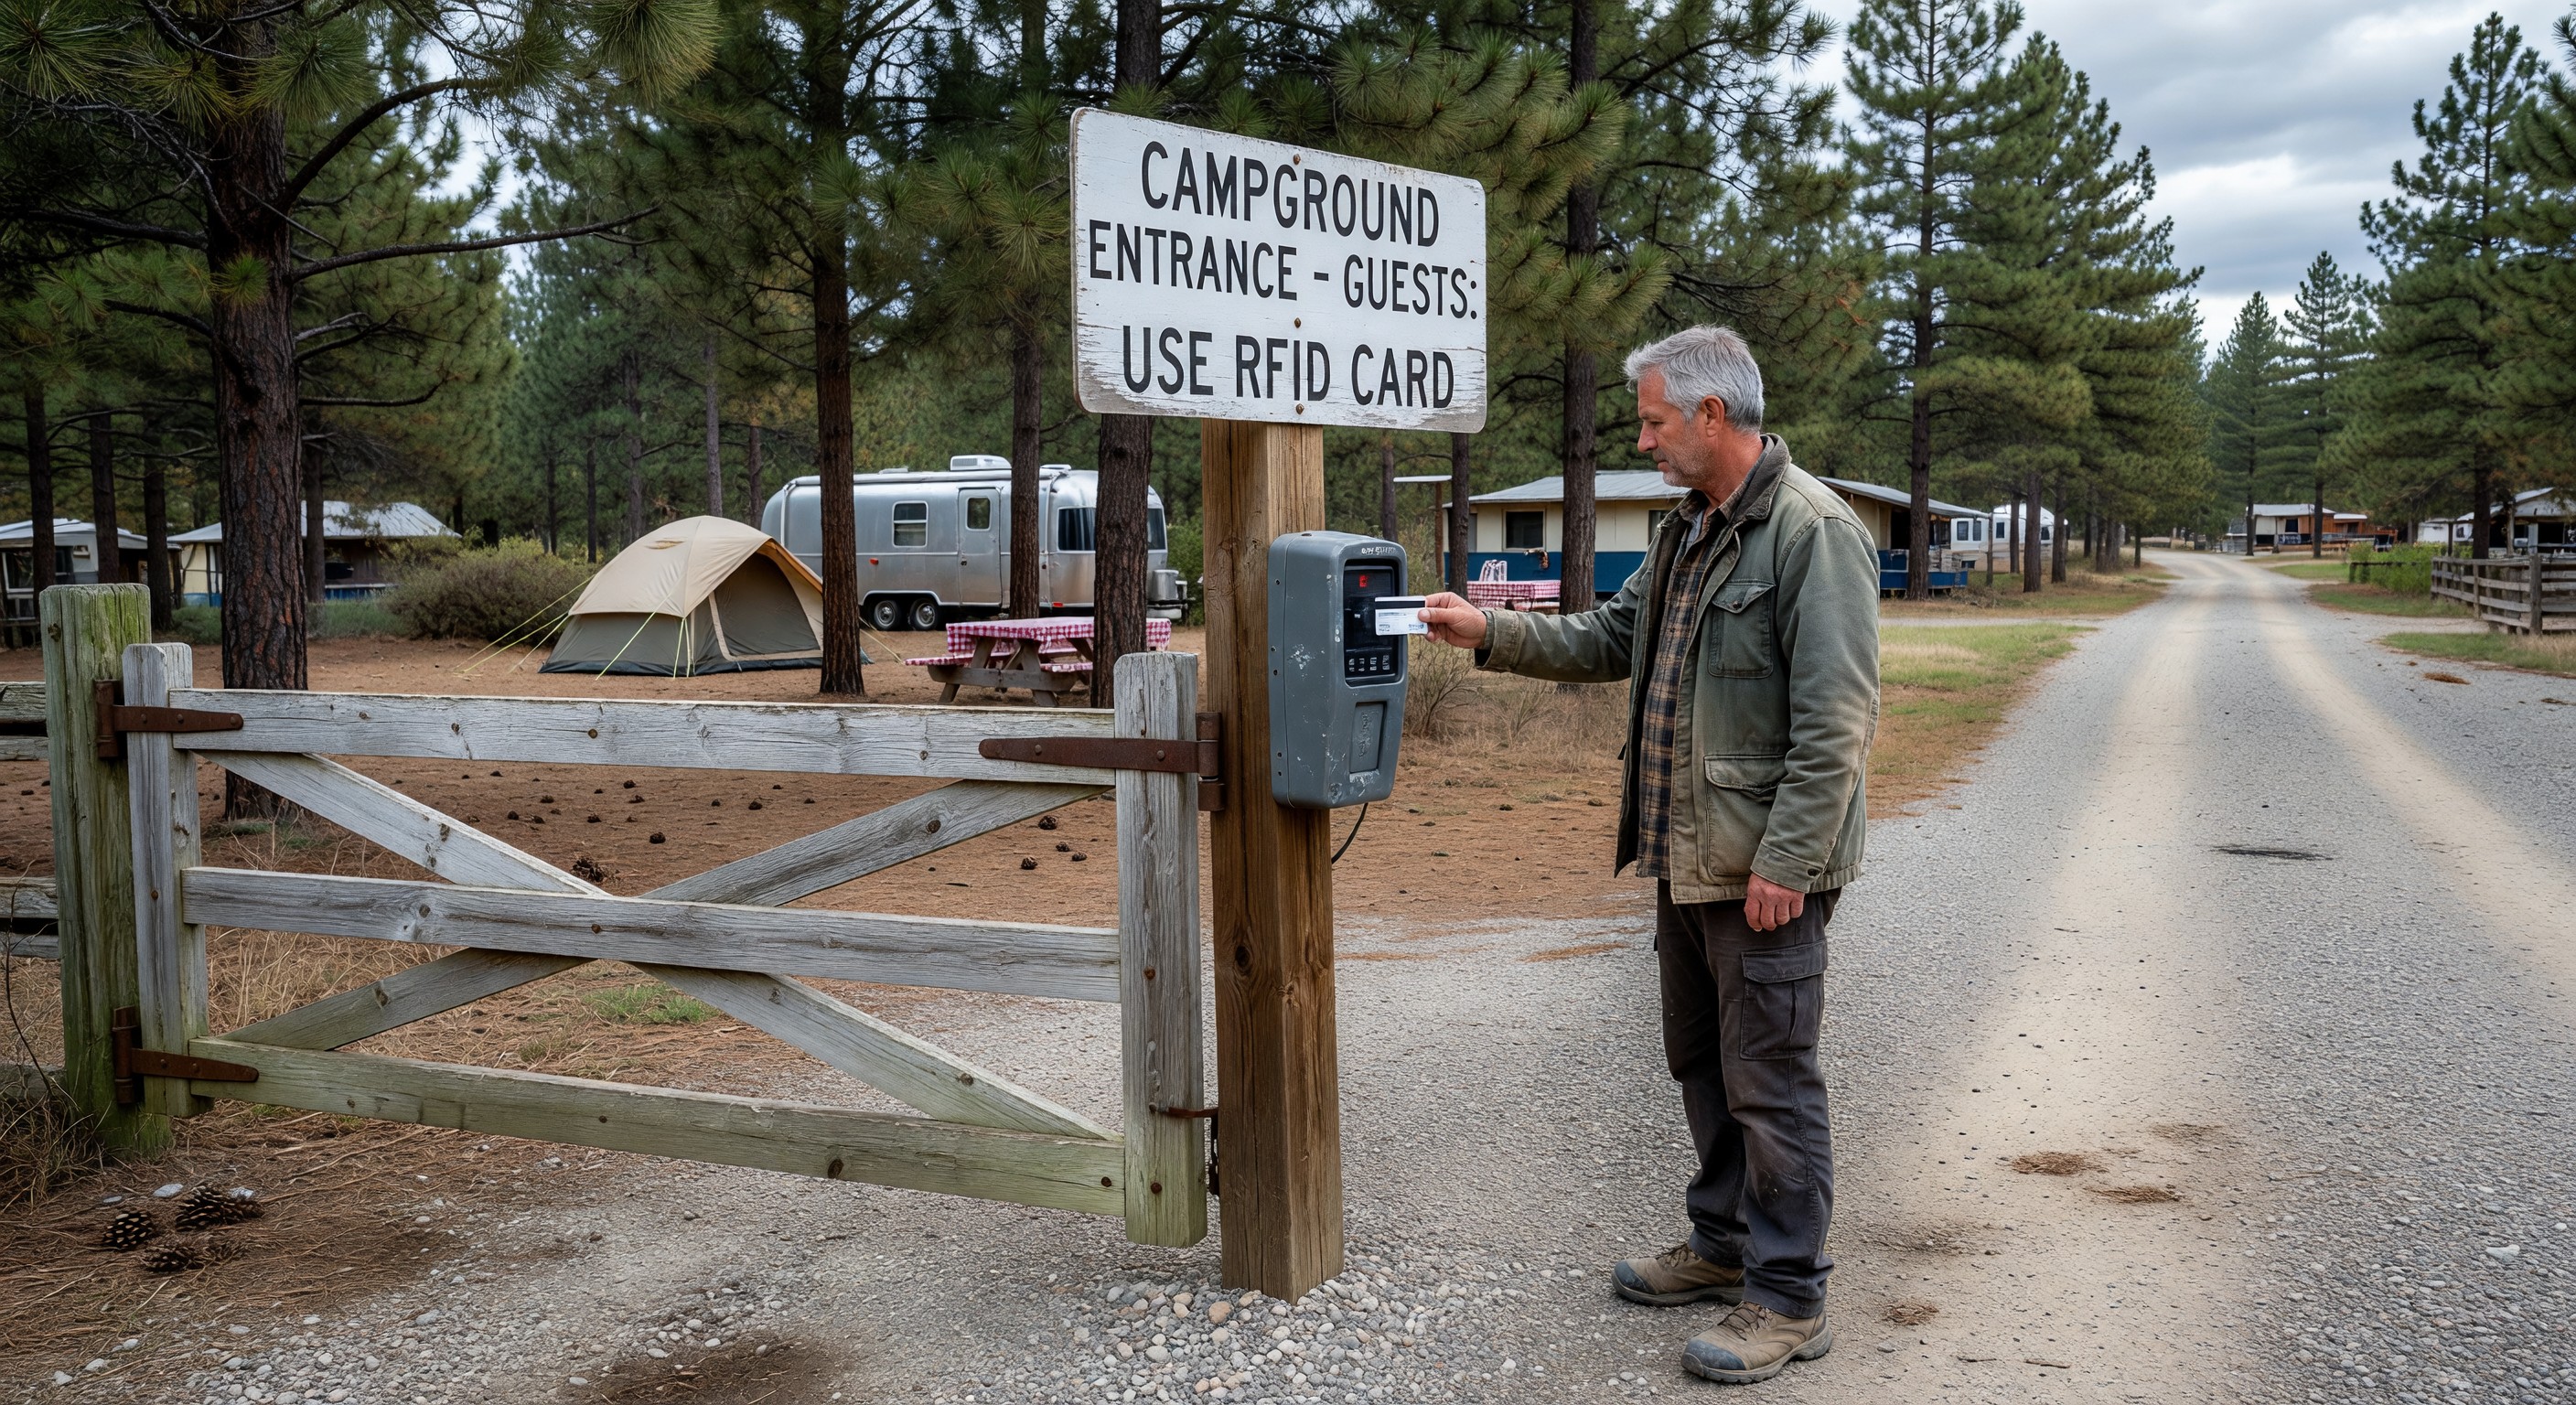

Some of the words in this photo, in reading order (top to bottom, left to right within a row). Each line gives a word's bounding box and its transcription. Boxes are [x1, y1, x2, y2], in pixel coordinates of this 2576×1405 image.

[1142, 141, 1439, 247] CAMPGROUND
[1089, 220, 1297, 301] ENTRANCE
[1344, 254, 1477, 319] GUESTS:
[1123, 325, 1214, 396] USE
[1236, 335, 1330, 402] RFID
[1352, 344, 1454, 409] CARD
